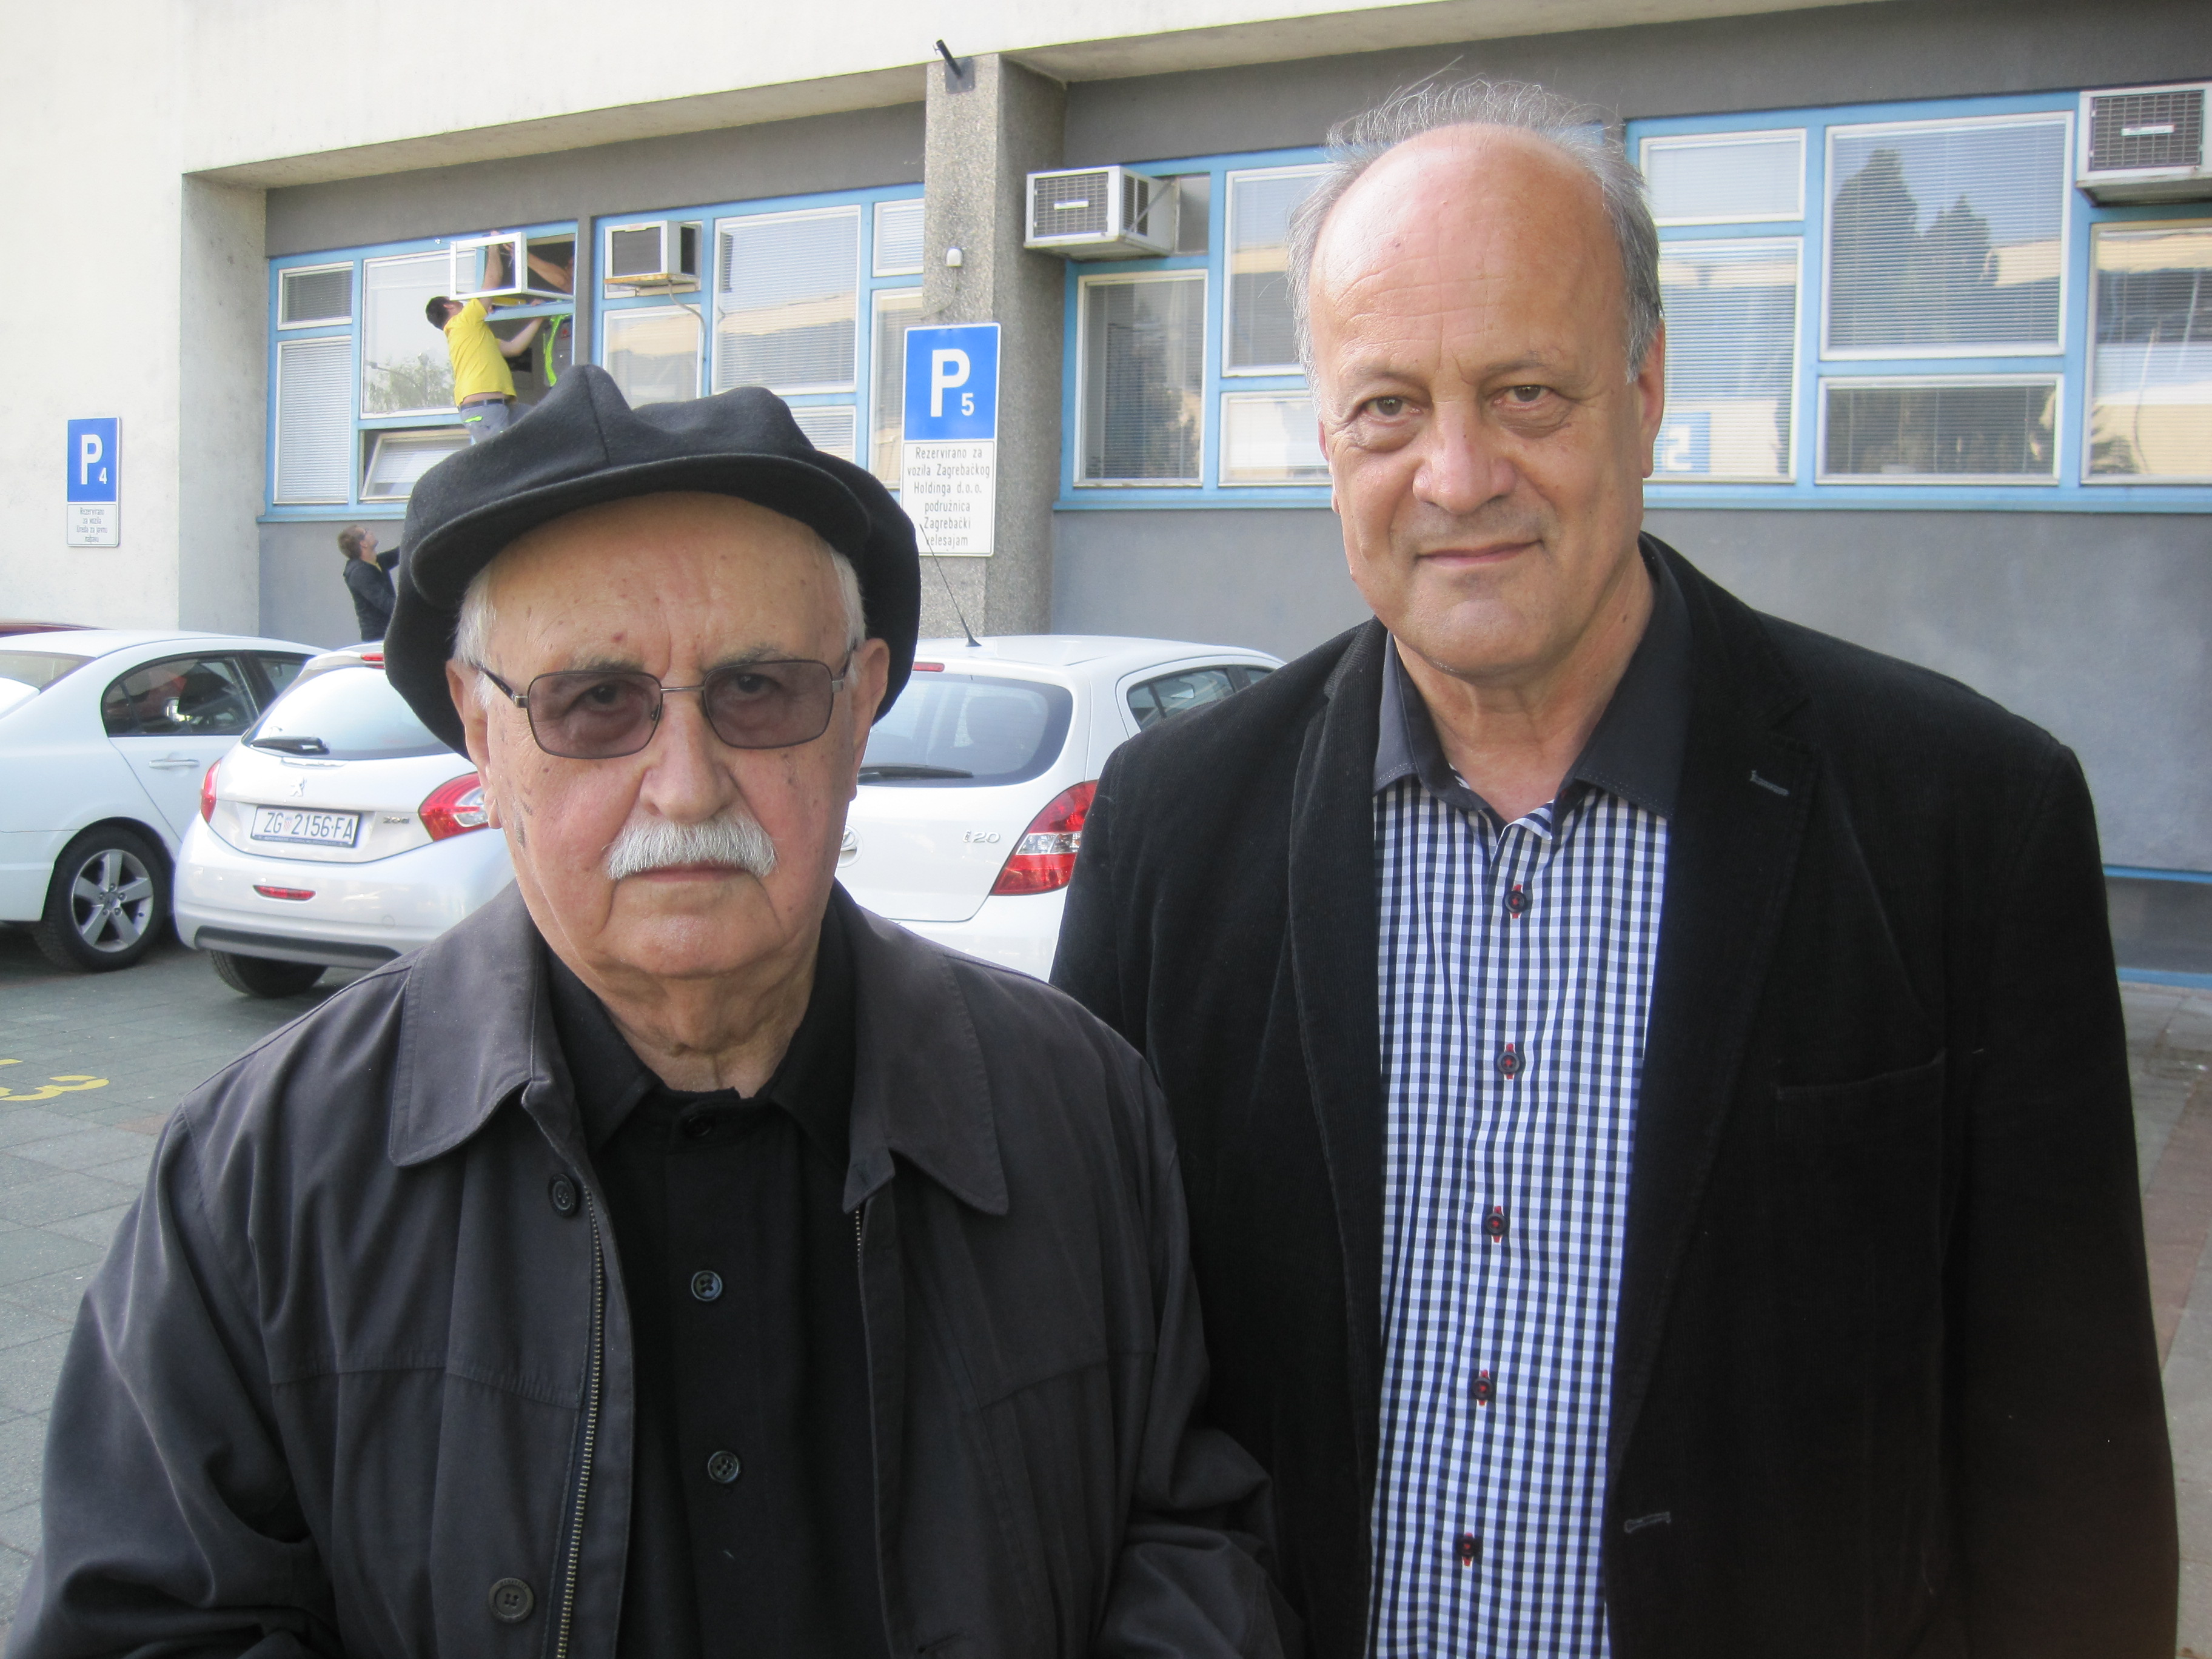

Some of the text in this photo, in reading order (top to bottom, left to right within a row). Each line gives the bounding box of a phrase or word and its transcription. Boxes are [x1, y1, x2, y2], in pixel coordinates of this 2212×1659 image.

[930, 348, 975, 417] P 5
[81, 434, 108, 485] P 4
[916, 447, 982, 459] Rezervirano za
[907, 463, 990, 479] vozila Zagrebačkog
[914, 481, 951, 497] Holdinga
[925, 500, 970, 514] podružnica
[924, 517, 971, 532] Zagrebački
[264, 813, 284, 833] ZG
